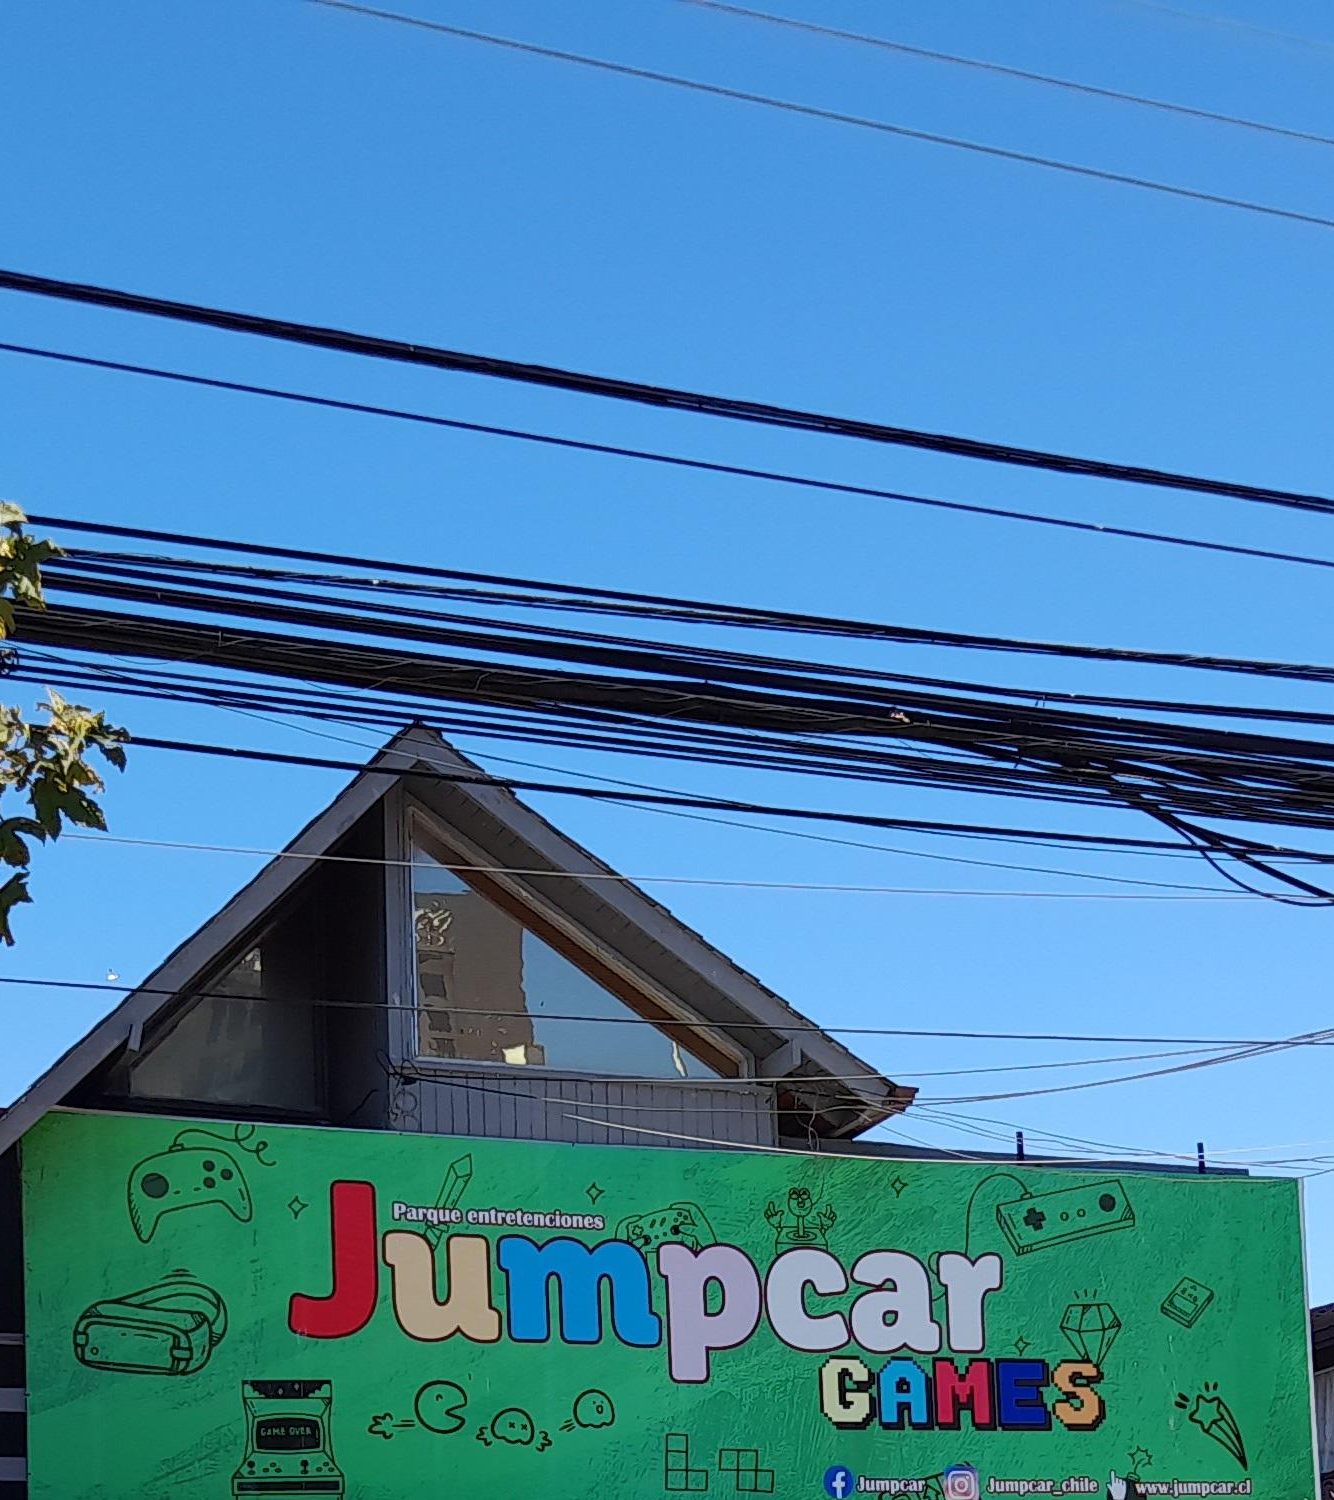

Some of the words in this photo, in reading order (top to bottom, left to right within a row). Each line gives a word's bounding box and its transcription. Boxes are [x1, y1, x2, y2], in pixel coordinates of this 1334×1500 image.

[392, 1201, 462, 1225] Parque
[466, 1207, 605, 1230] entretenciones
[288, 1179, 1003, 1384] Jumpcar
[818, 1355, 1107, 1432] GAMES
[260, 1426, 286, 1437] GAME
[288, 1426, 312, 1436] OVER
[856, 1475, 926, 1497] Jumpcar
[986, 1476, 1098, 1497] Jumpcar_chile
[1135, 1478, 1252, 1499] www.jumpcar.cl
